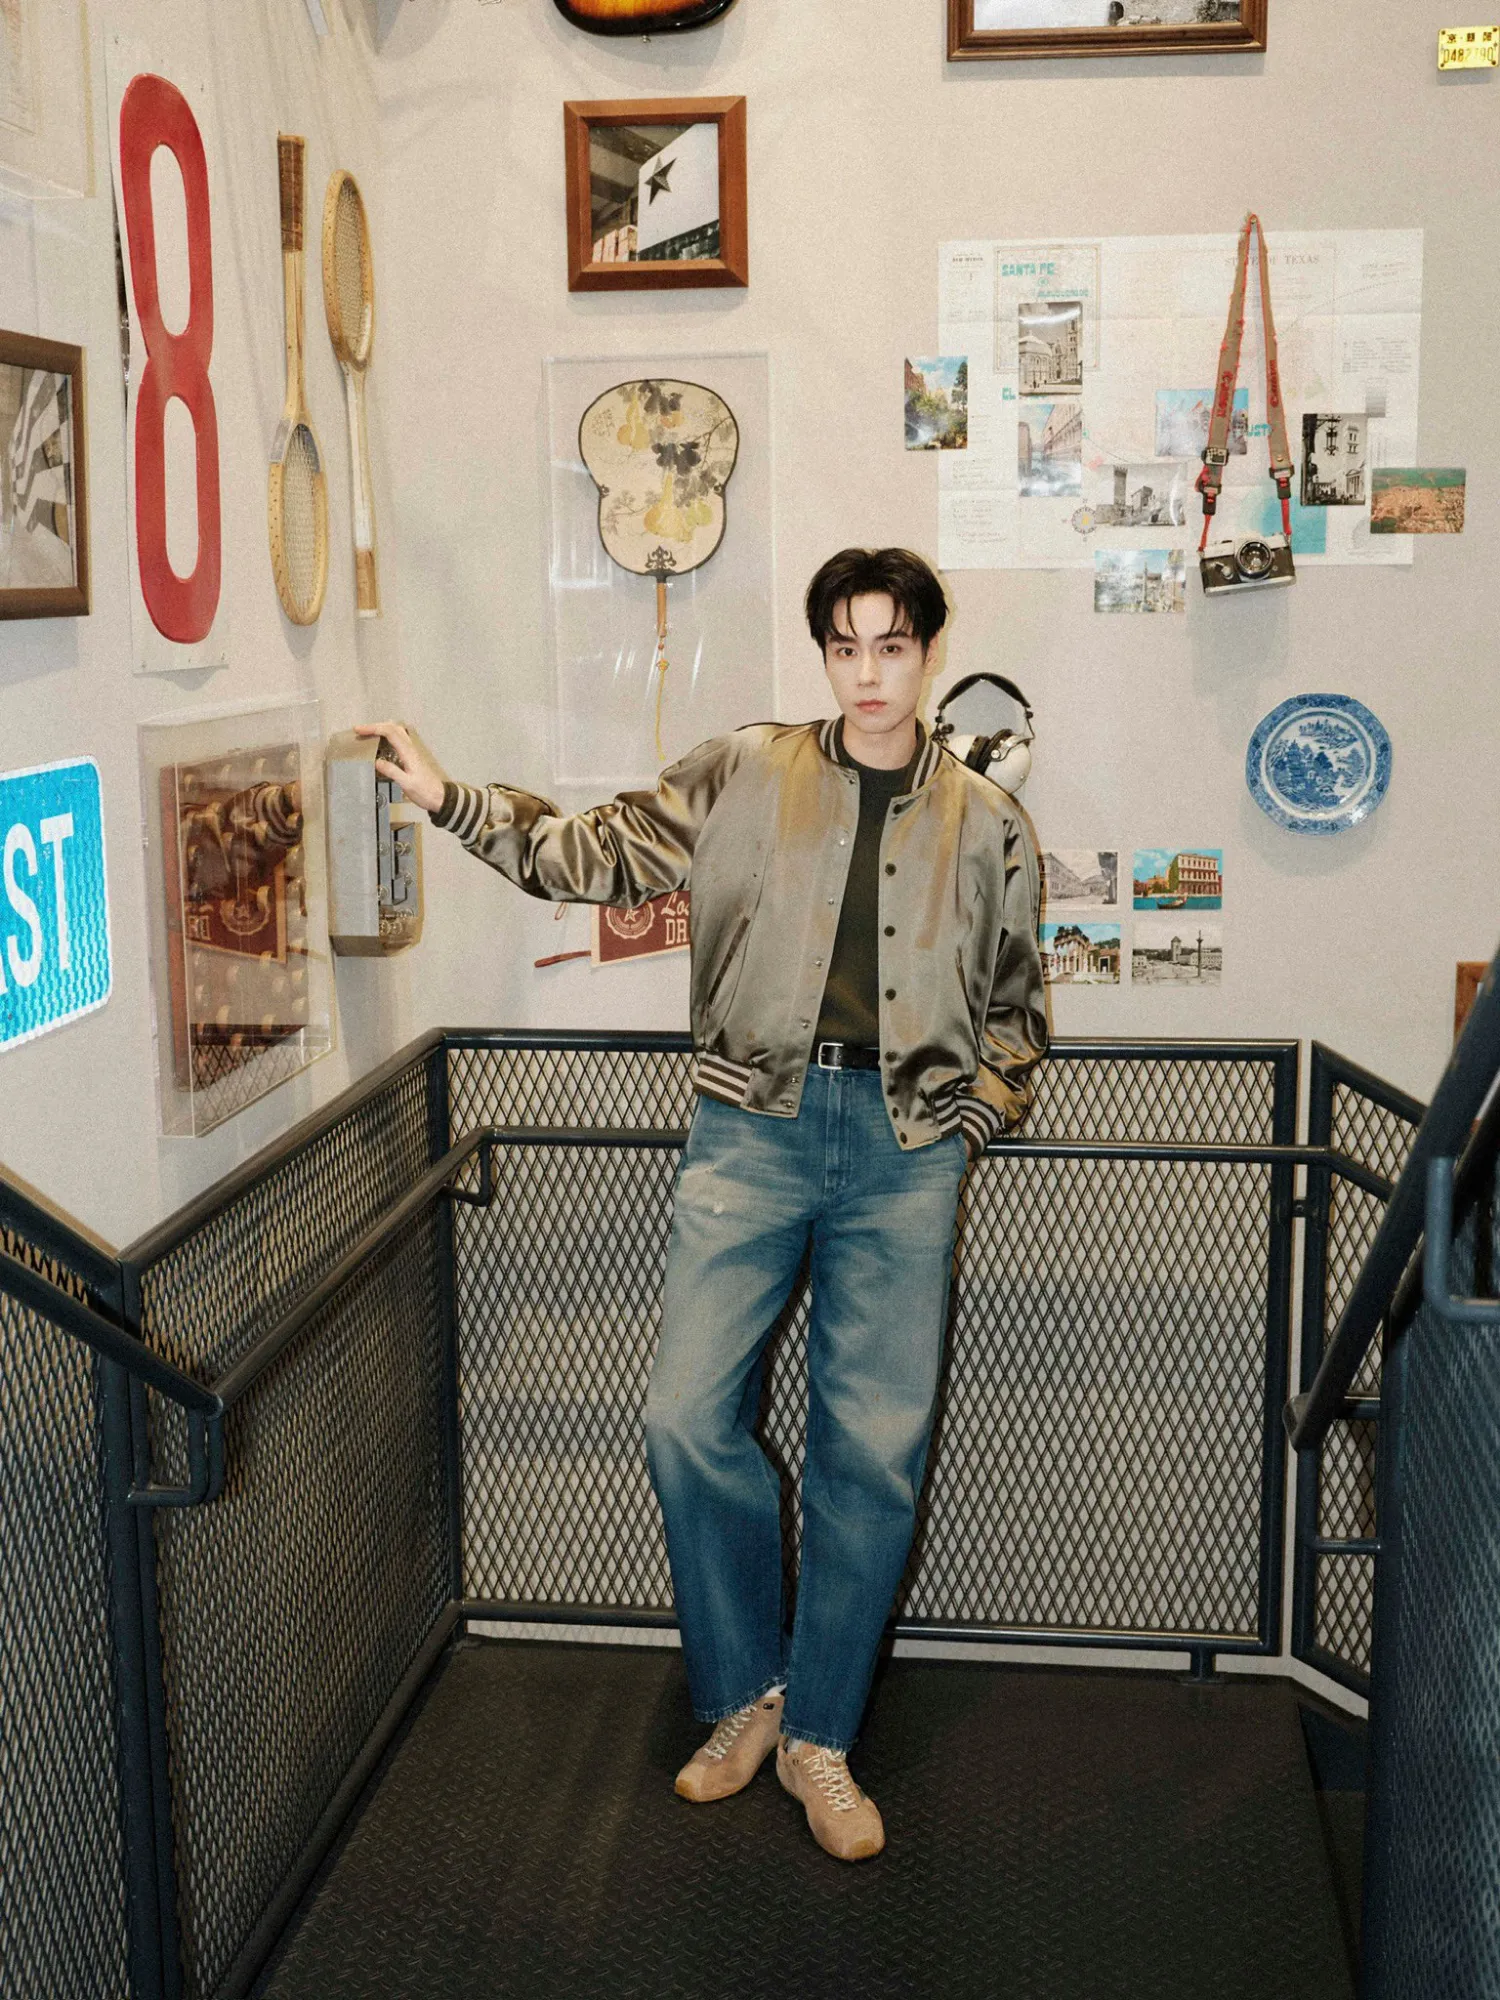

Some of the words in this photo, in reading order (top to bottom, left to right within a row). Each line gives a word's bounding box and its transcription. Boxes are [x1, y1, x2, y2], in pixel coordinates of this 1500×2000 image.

[1001, 263, 1036, 277] SANTA
[1284, 255, 1319, 265] TEXAS
[120, 72, 222, 646] 8
[0, 811, 75, 997] ST
[665, 918, 689, 946] DA
